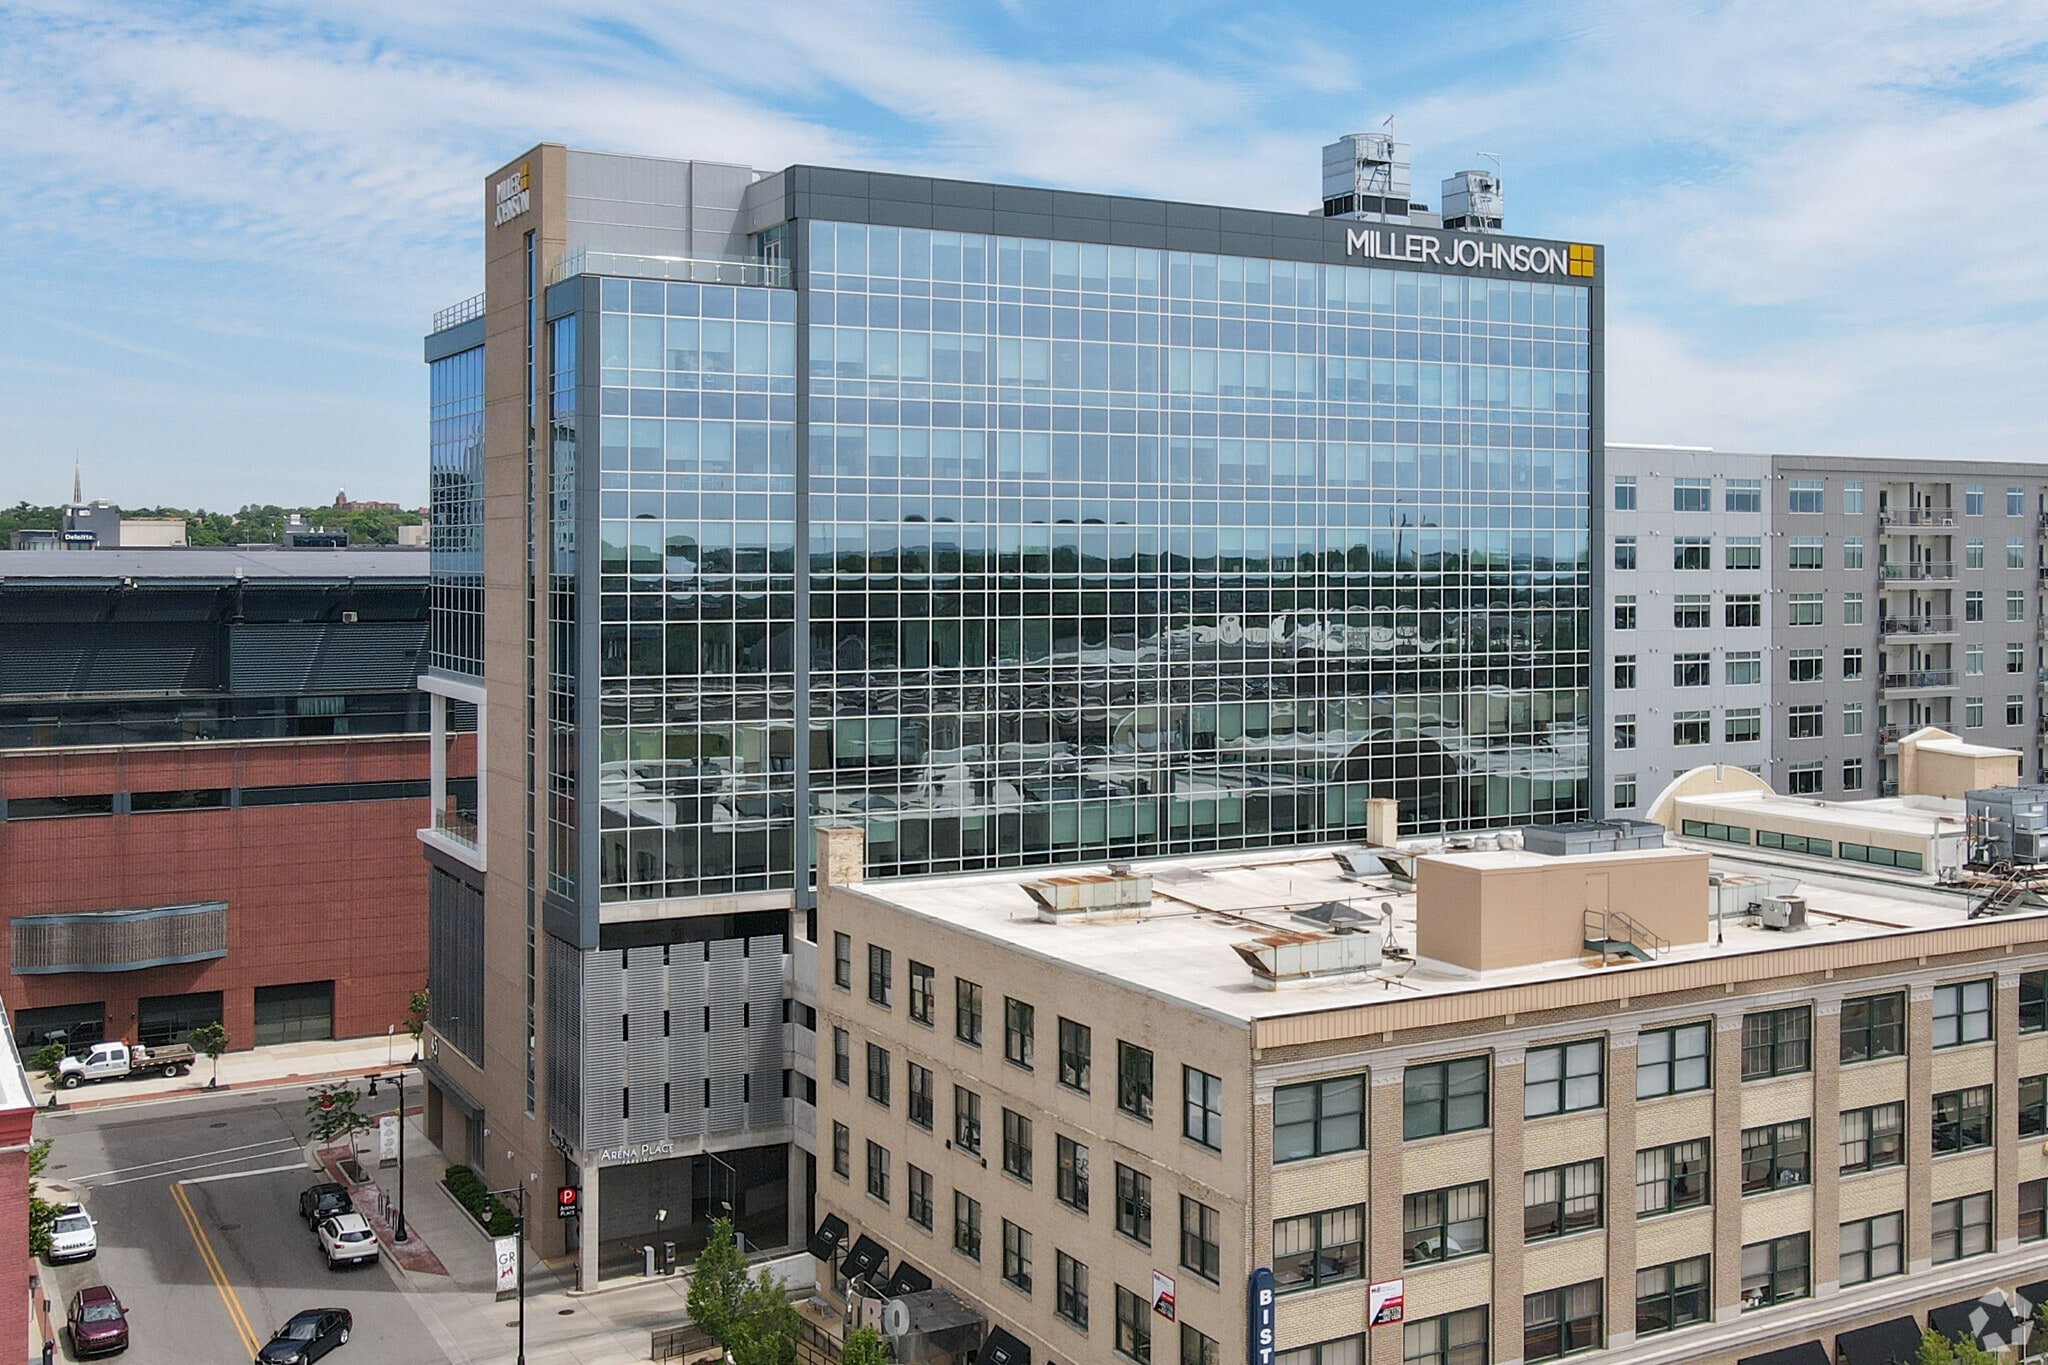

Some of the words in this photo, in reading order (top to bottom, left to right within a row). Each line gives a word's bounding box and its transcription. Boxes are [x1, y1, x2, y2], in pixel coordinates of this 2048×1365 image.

[1347, 228, 1440, 264] MILLER
[1444, 239, 1567, 275] JOHNSON
[601, 1149, 637, 1161] ARENA
[641, 1144, 674, 1156] PLACE
[498, 1251, 516, 1265] GR
[1259, 1289, 1273, 1364] BIST
